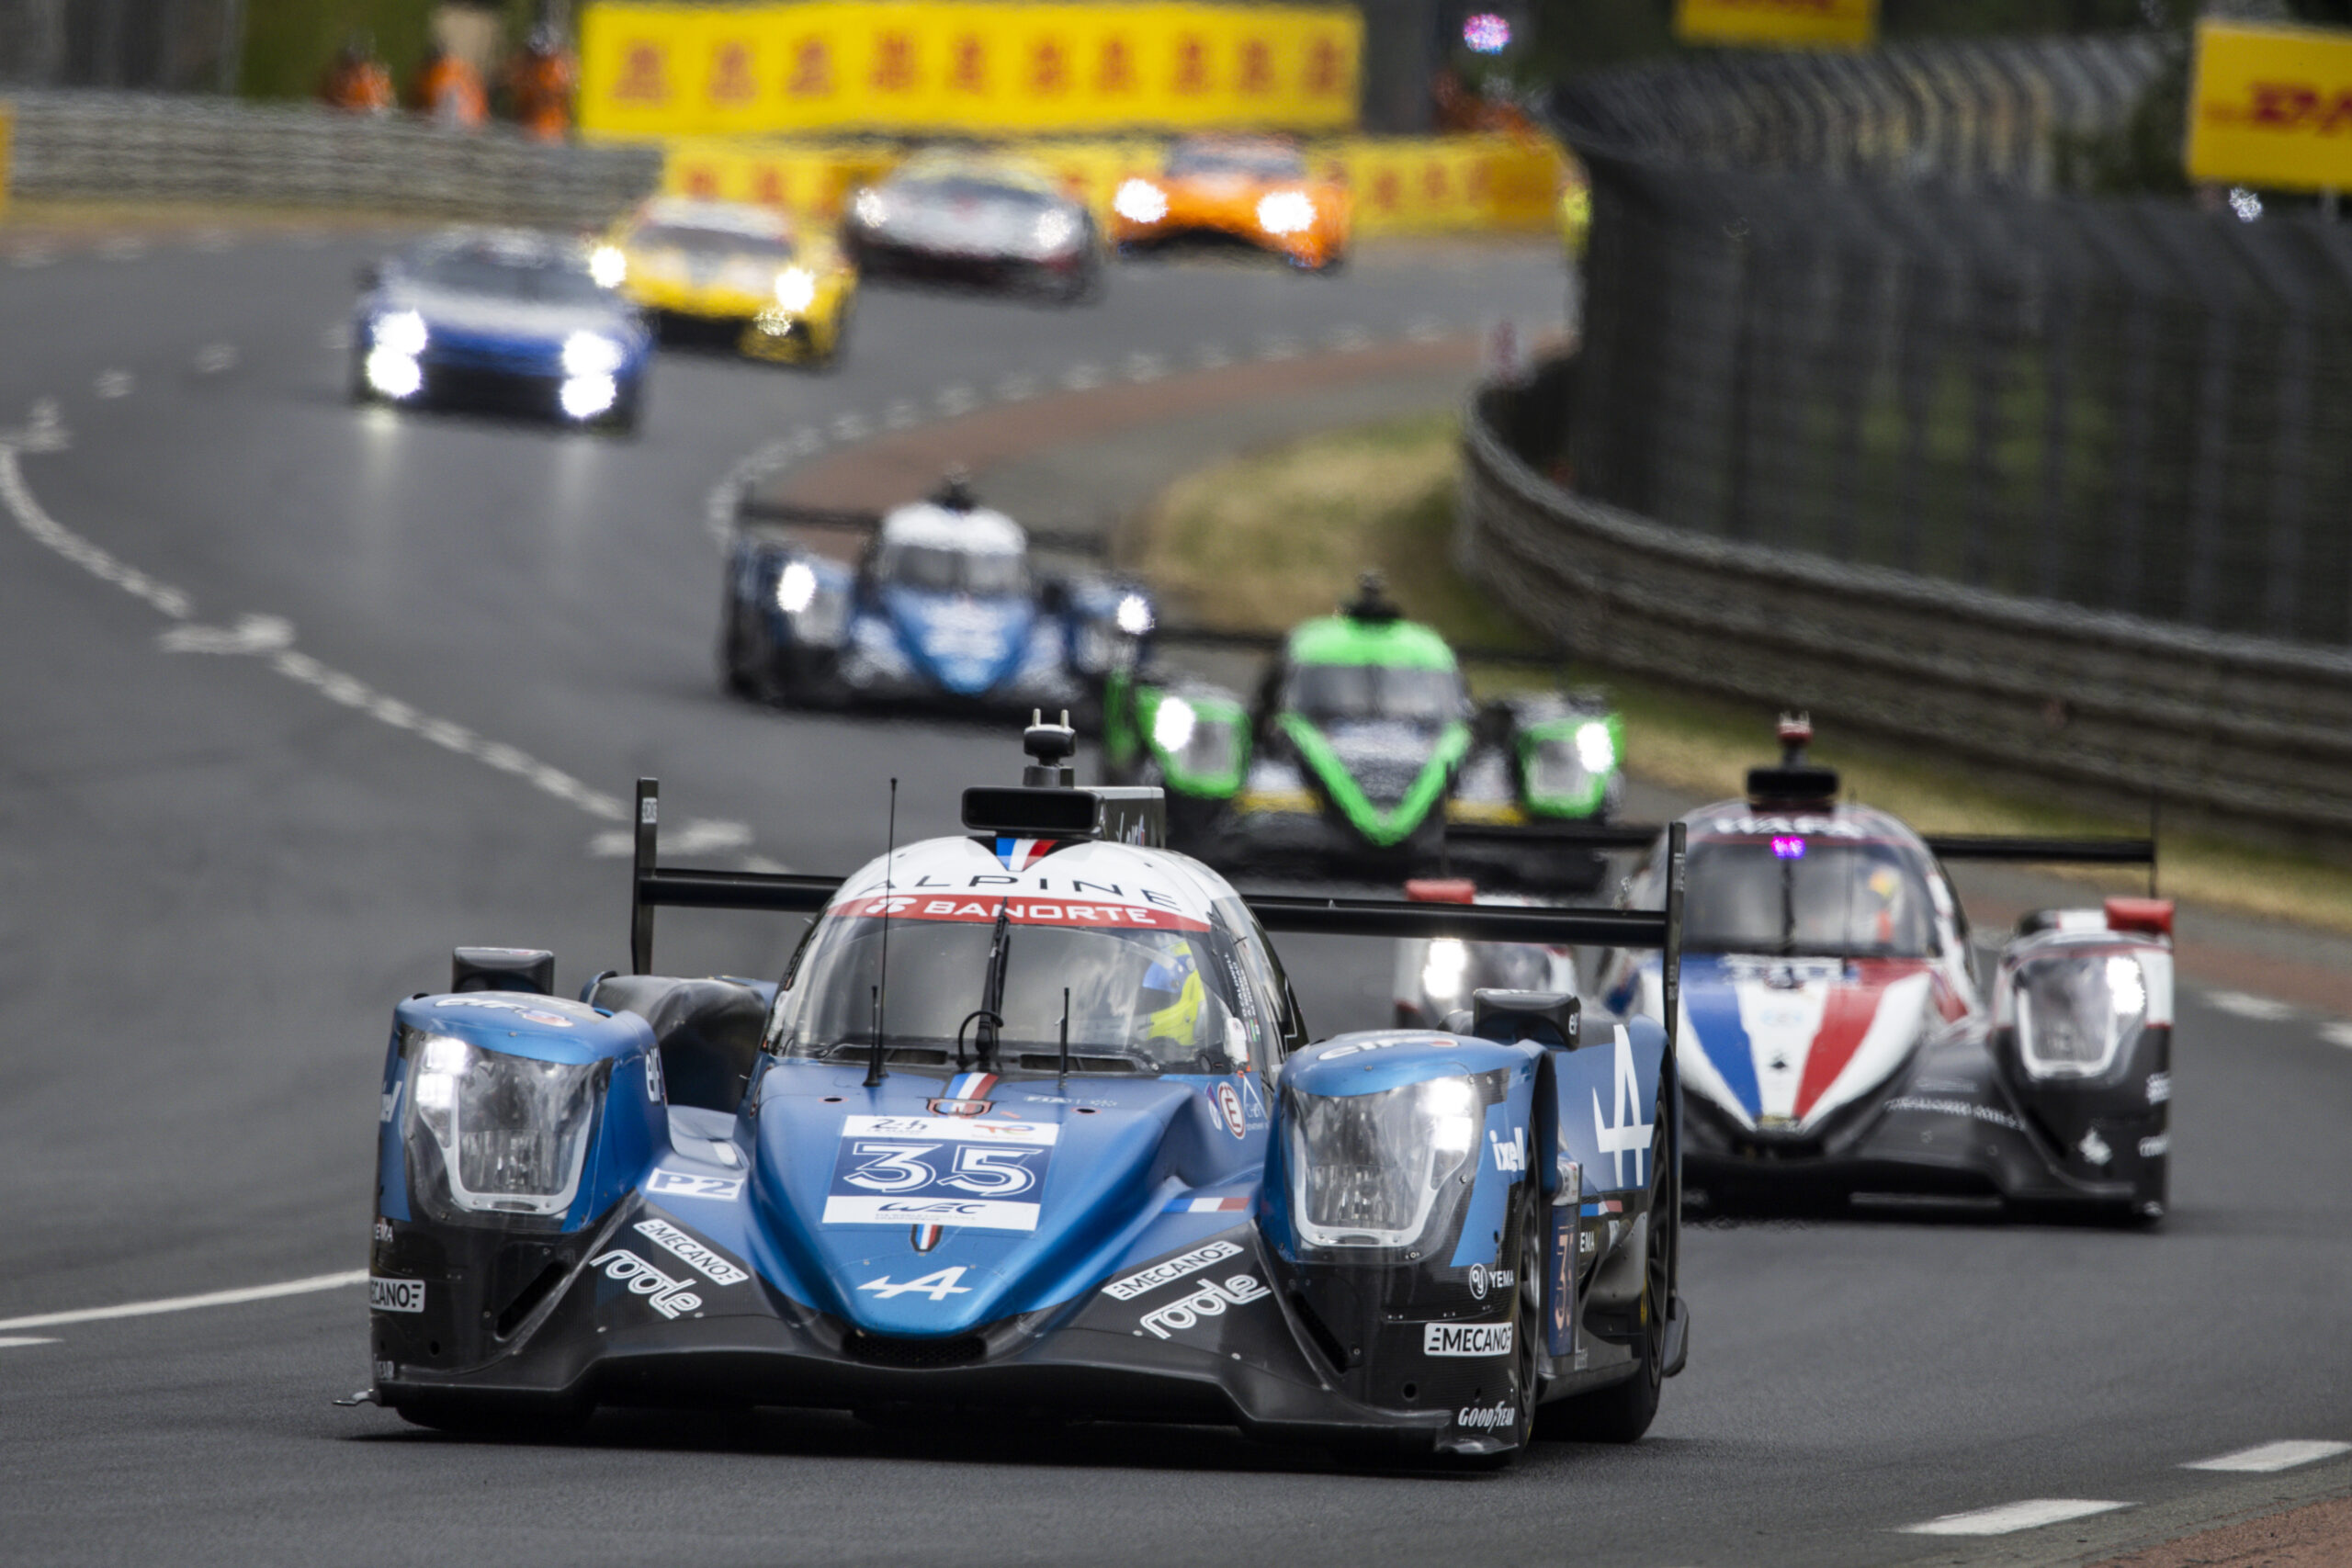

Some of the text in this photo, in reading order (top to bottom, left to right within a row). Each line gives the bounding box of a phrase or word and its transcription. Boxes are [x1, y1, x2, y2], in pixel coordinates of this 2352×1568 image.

[857, 874, 1182, 911] ALPINE
[923, 900, 1157, 924] BANORTE
[842, 1141, 1045, 1197] 35
[653, 1170, 737, 1195] P2
[877, 1201, 988, 1214] WEC
[1579, 1231, 1595, 1253] EMA
[1488, 1269, 1514, 1288] YEMA
[1458, 1401, 1515, 1434] GOODYEAR
